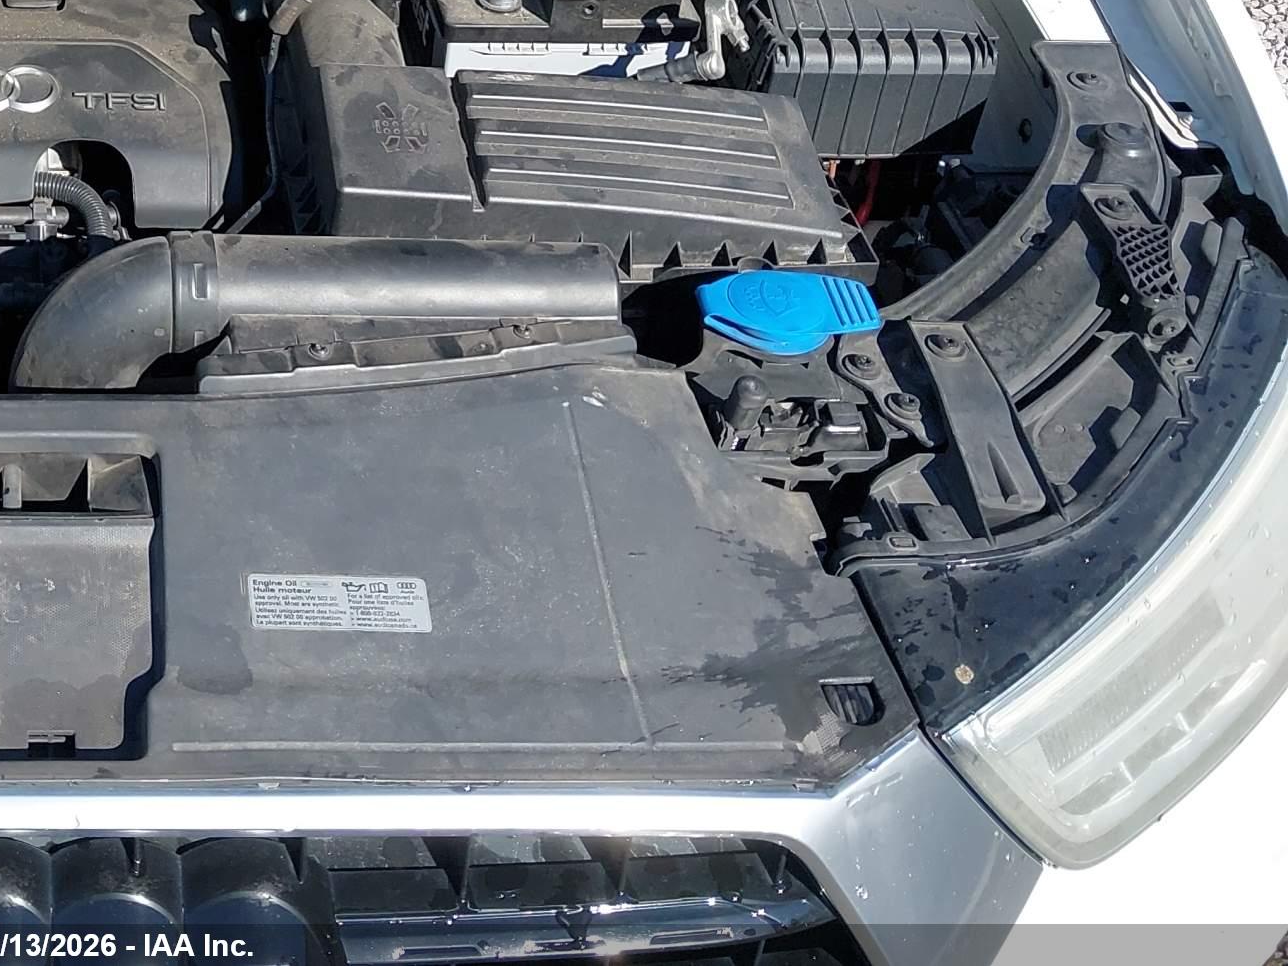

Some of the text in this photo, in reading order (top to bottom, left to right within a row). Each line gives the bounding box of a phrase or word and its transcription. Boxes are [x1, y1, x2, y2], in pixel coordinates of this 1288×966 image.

[72, 92, 167, 111] TFSI
[252, 579, 297, 587] Engine Oil
